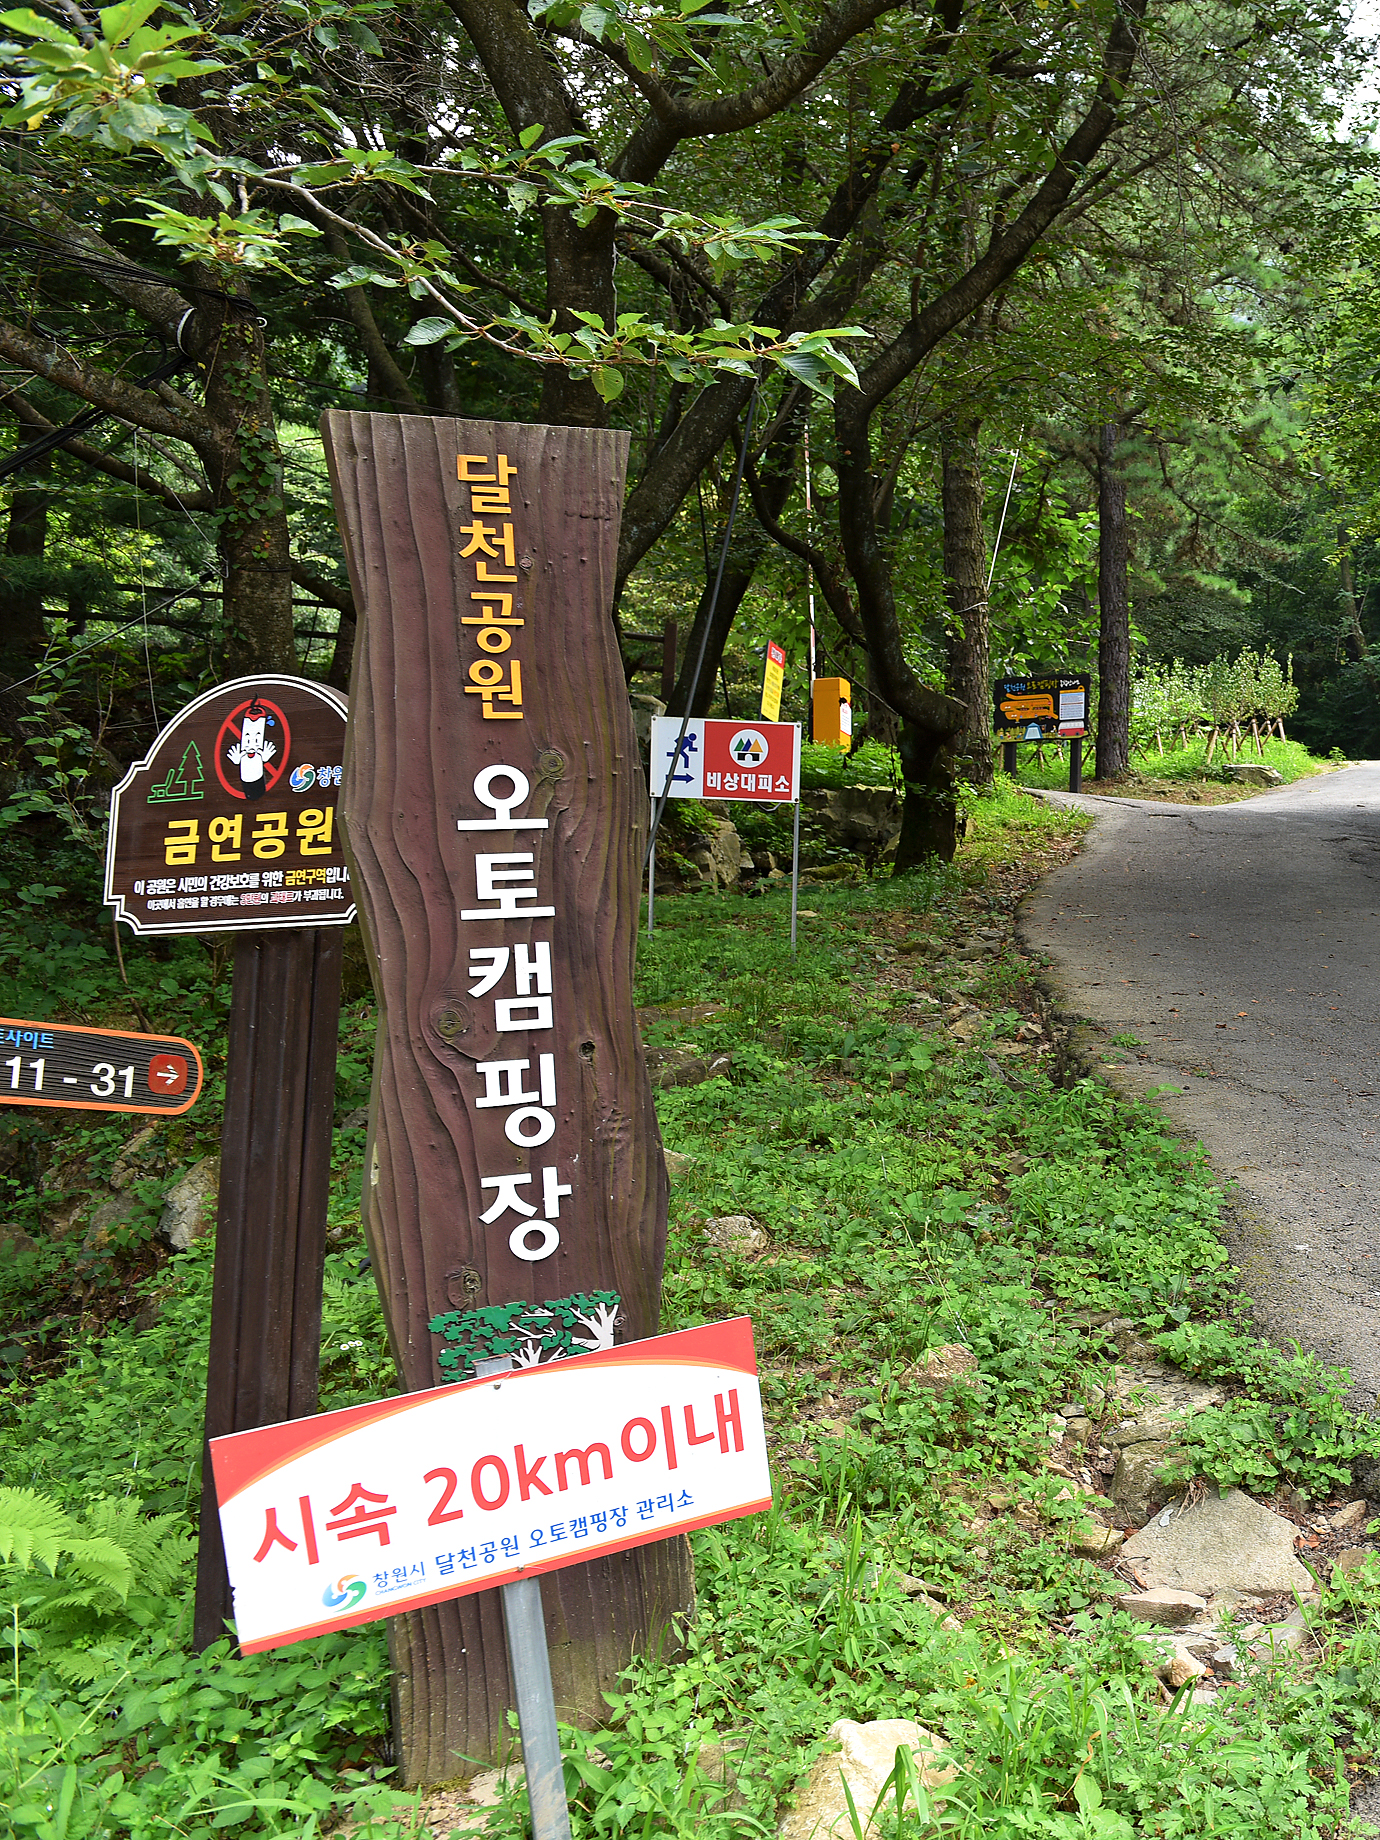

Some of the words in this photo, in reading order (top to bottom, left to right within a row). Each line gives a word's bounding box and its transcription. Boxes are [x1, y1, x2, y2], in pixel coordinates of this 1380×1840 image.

[456, 454, 525, 720] 달천공원
[706, 771, 790, 793] 비상대피소
[164, 806, 334, 866] 금연공원
[134, 880, 145, 896] 이
[146, 878, 177, 895] 공원은
[177, 875, 208, 893] 시민의
[209, 871, 260, 891] 건강보호를
[261, 870, 284, 887] 위한
[285, 866, 350, 886] 금연구역입니
[146, 898, 177, 911] 이곳에서
[209, 894, 240, 907] 경우에는
[456, 763, 573, 1262] 오토캠핑장
[5, 1055, 45, 1091] 11
[90, 1062, 135, 1098] 31
[253, 1482, 398, 1566] 시속
[423, 1388, 745, 1527] 20km이내
[372, 1561, 425, 1588] 창원시
[435, 1534, 520, 1576] 달천공원
[528, 1505, 629, 1549] 오토캠핑장
[636, 1489, 695, 1521] 관리소
